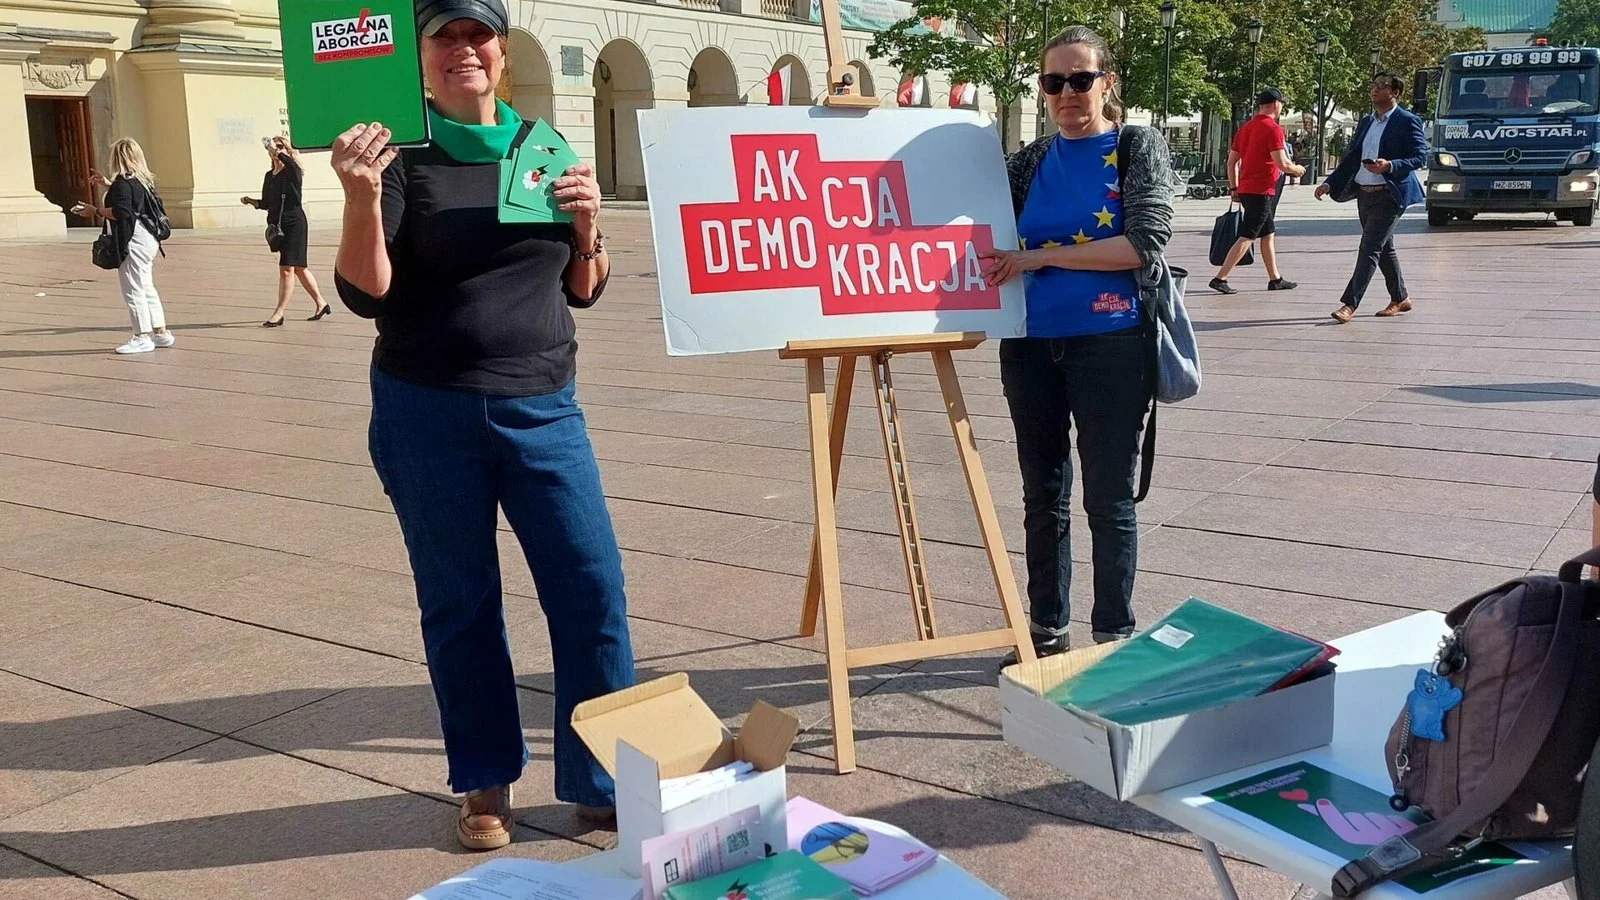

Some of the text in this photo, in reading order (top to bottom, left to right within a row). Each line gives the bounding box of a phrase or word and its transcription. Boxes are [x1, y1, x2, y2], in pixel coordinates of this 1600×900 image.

[316, 8, 389, 38] LEGALNA
[318, 32, 389, 51] ABORCJA
[318, 53, 331, 61] BEZ
[1462, 51, 1581, 68] 607 98 99 99
[753, 148, 808, 203] AK
[821, 176, 902, 230] CJA
[700, 216, 818, 275] DEMO
[827, 240, 987, 297] KRACJA
